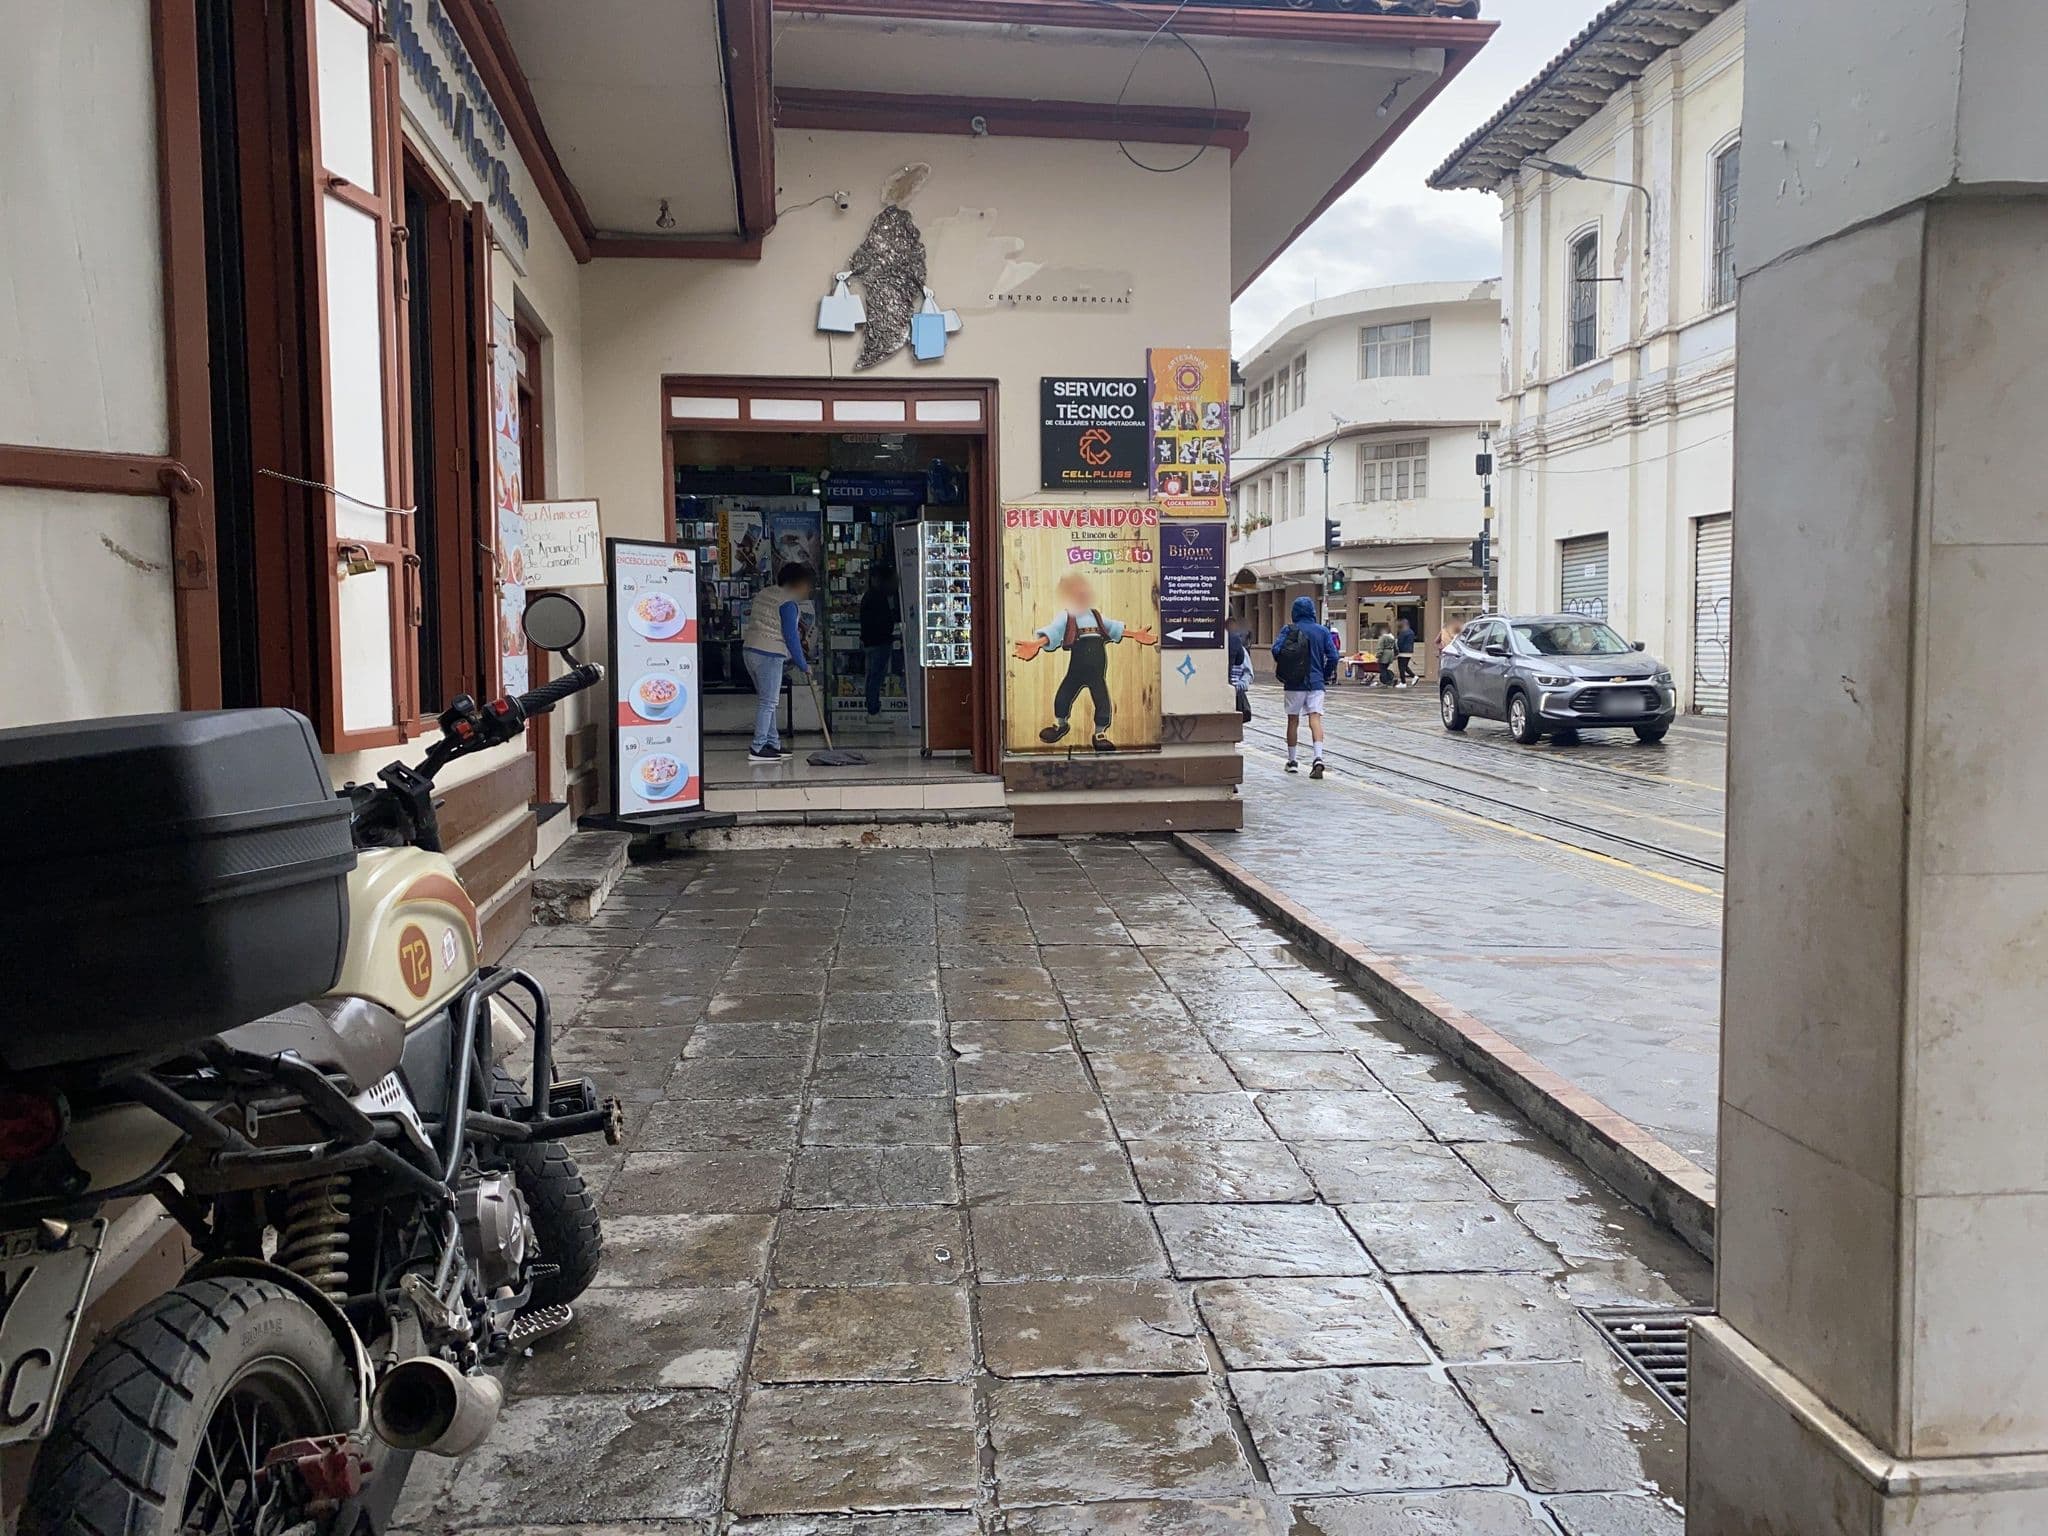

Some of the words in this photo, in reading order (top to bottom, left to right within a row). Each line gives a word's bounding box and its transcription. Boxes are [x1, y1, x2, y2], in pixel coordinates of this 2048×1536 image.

[988, 293, 1042, 302] CENTRO
[1052, 295, 1130, 304] COMERCIAL
[1053, 381, 1137, 397] SERVICIO
[1056, 400, 1135, 419] TÉCNICO
[1061, 470, 1133, 478] CELLPLUSS
[826, 486, 863, 497] TECNO
[1005, 506, 1159, 529] BIENVENIDOS
[1081, 531, 1107, 539] Rincón
[1108, 531, 1118, 539] de
[1068, 547, 1151, 564] Geppetto
[1168, 544, 1213, 559] Bijoux
[616, 556, 667, 567] ENCEBOLLADOS
[1370, 582, 1410, 594] Royal
[401, 939, 430, 985] 72
